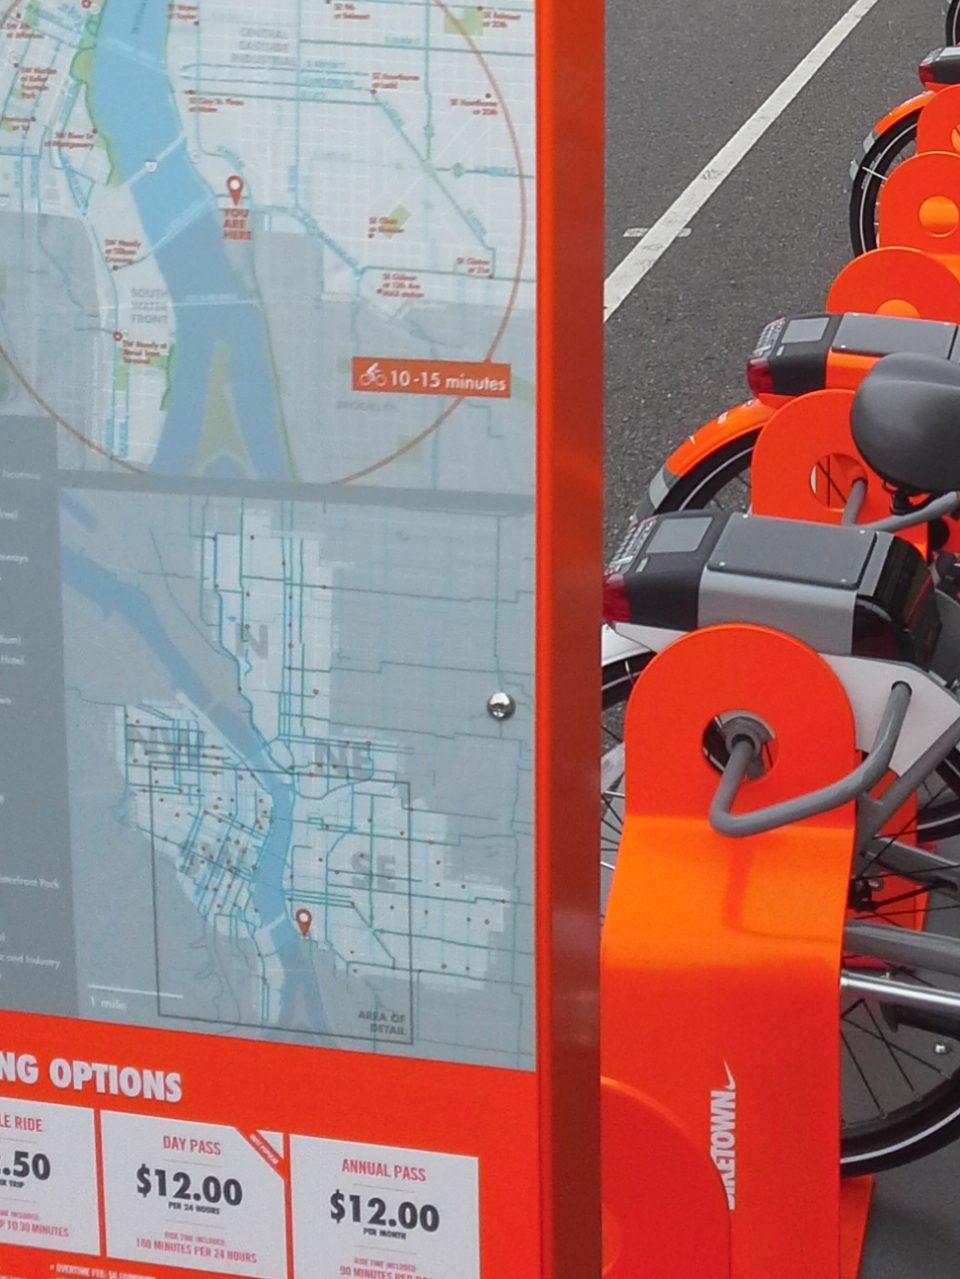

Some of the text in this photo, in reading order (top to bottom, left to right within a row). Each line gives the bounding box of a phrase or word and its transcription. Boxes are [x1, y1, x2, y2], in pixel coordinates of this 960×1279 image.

[445, 376, 506, 392] minutes
[50, 1057, 183, 1104] OPTIONS
[15, 1116, 43, 1133] RIDE
[163, 1135, 221, 1156] DAY PASS
[0, 1150, 51, 1181] .50
[342, 1158, 427, 1182] ANNUAL PASS
[137, 1163, 243, 1206] $12.00
[168, 1201, 182, 1210] PER
[196, 1205, 221, 1215] HOURS
[330, 1189, 440, 1233] $12.00
[32, 1223, 70, 1238] MINUTES
[363, 1227, 407, 1240] PER MONTH
[154, 1240, 191, 1255] MINUTES
[194, 1245, 212, 1258] PER
[214, 1248, 225, 1260] 24
[227, 1250, 258, 1264] HOURS
[353, 1268, 393, 1279] MINUTES
